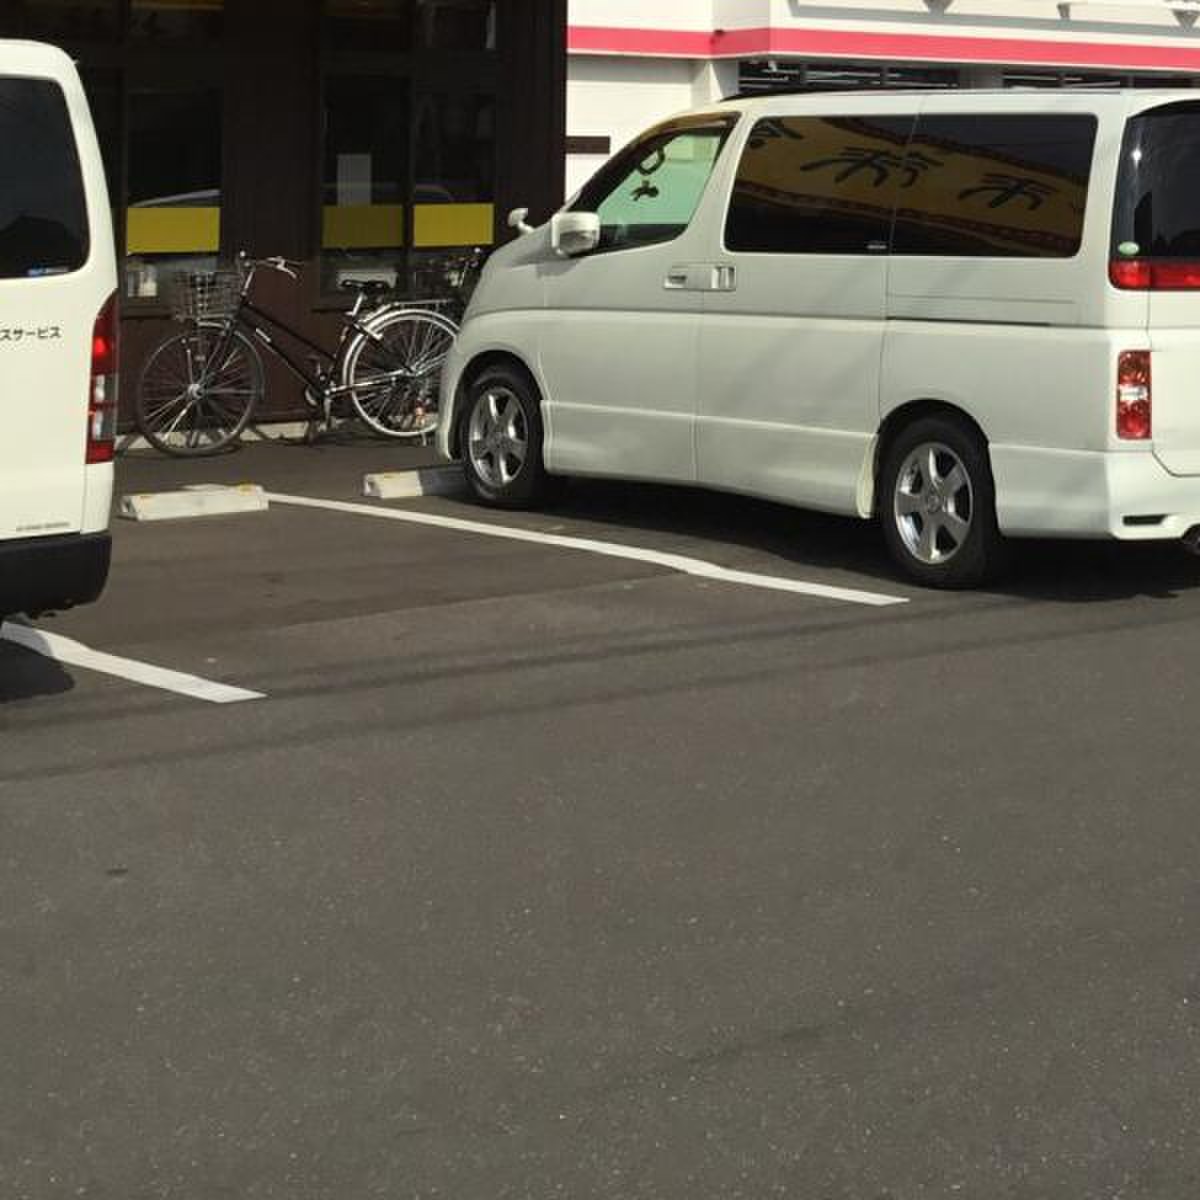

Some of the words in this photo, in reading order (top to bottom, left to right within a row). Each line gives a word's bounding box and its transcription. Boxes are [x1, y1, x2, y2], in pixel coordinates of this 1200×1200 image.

[0, 326, 62, 341] スサービス
